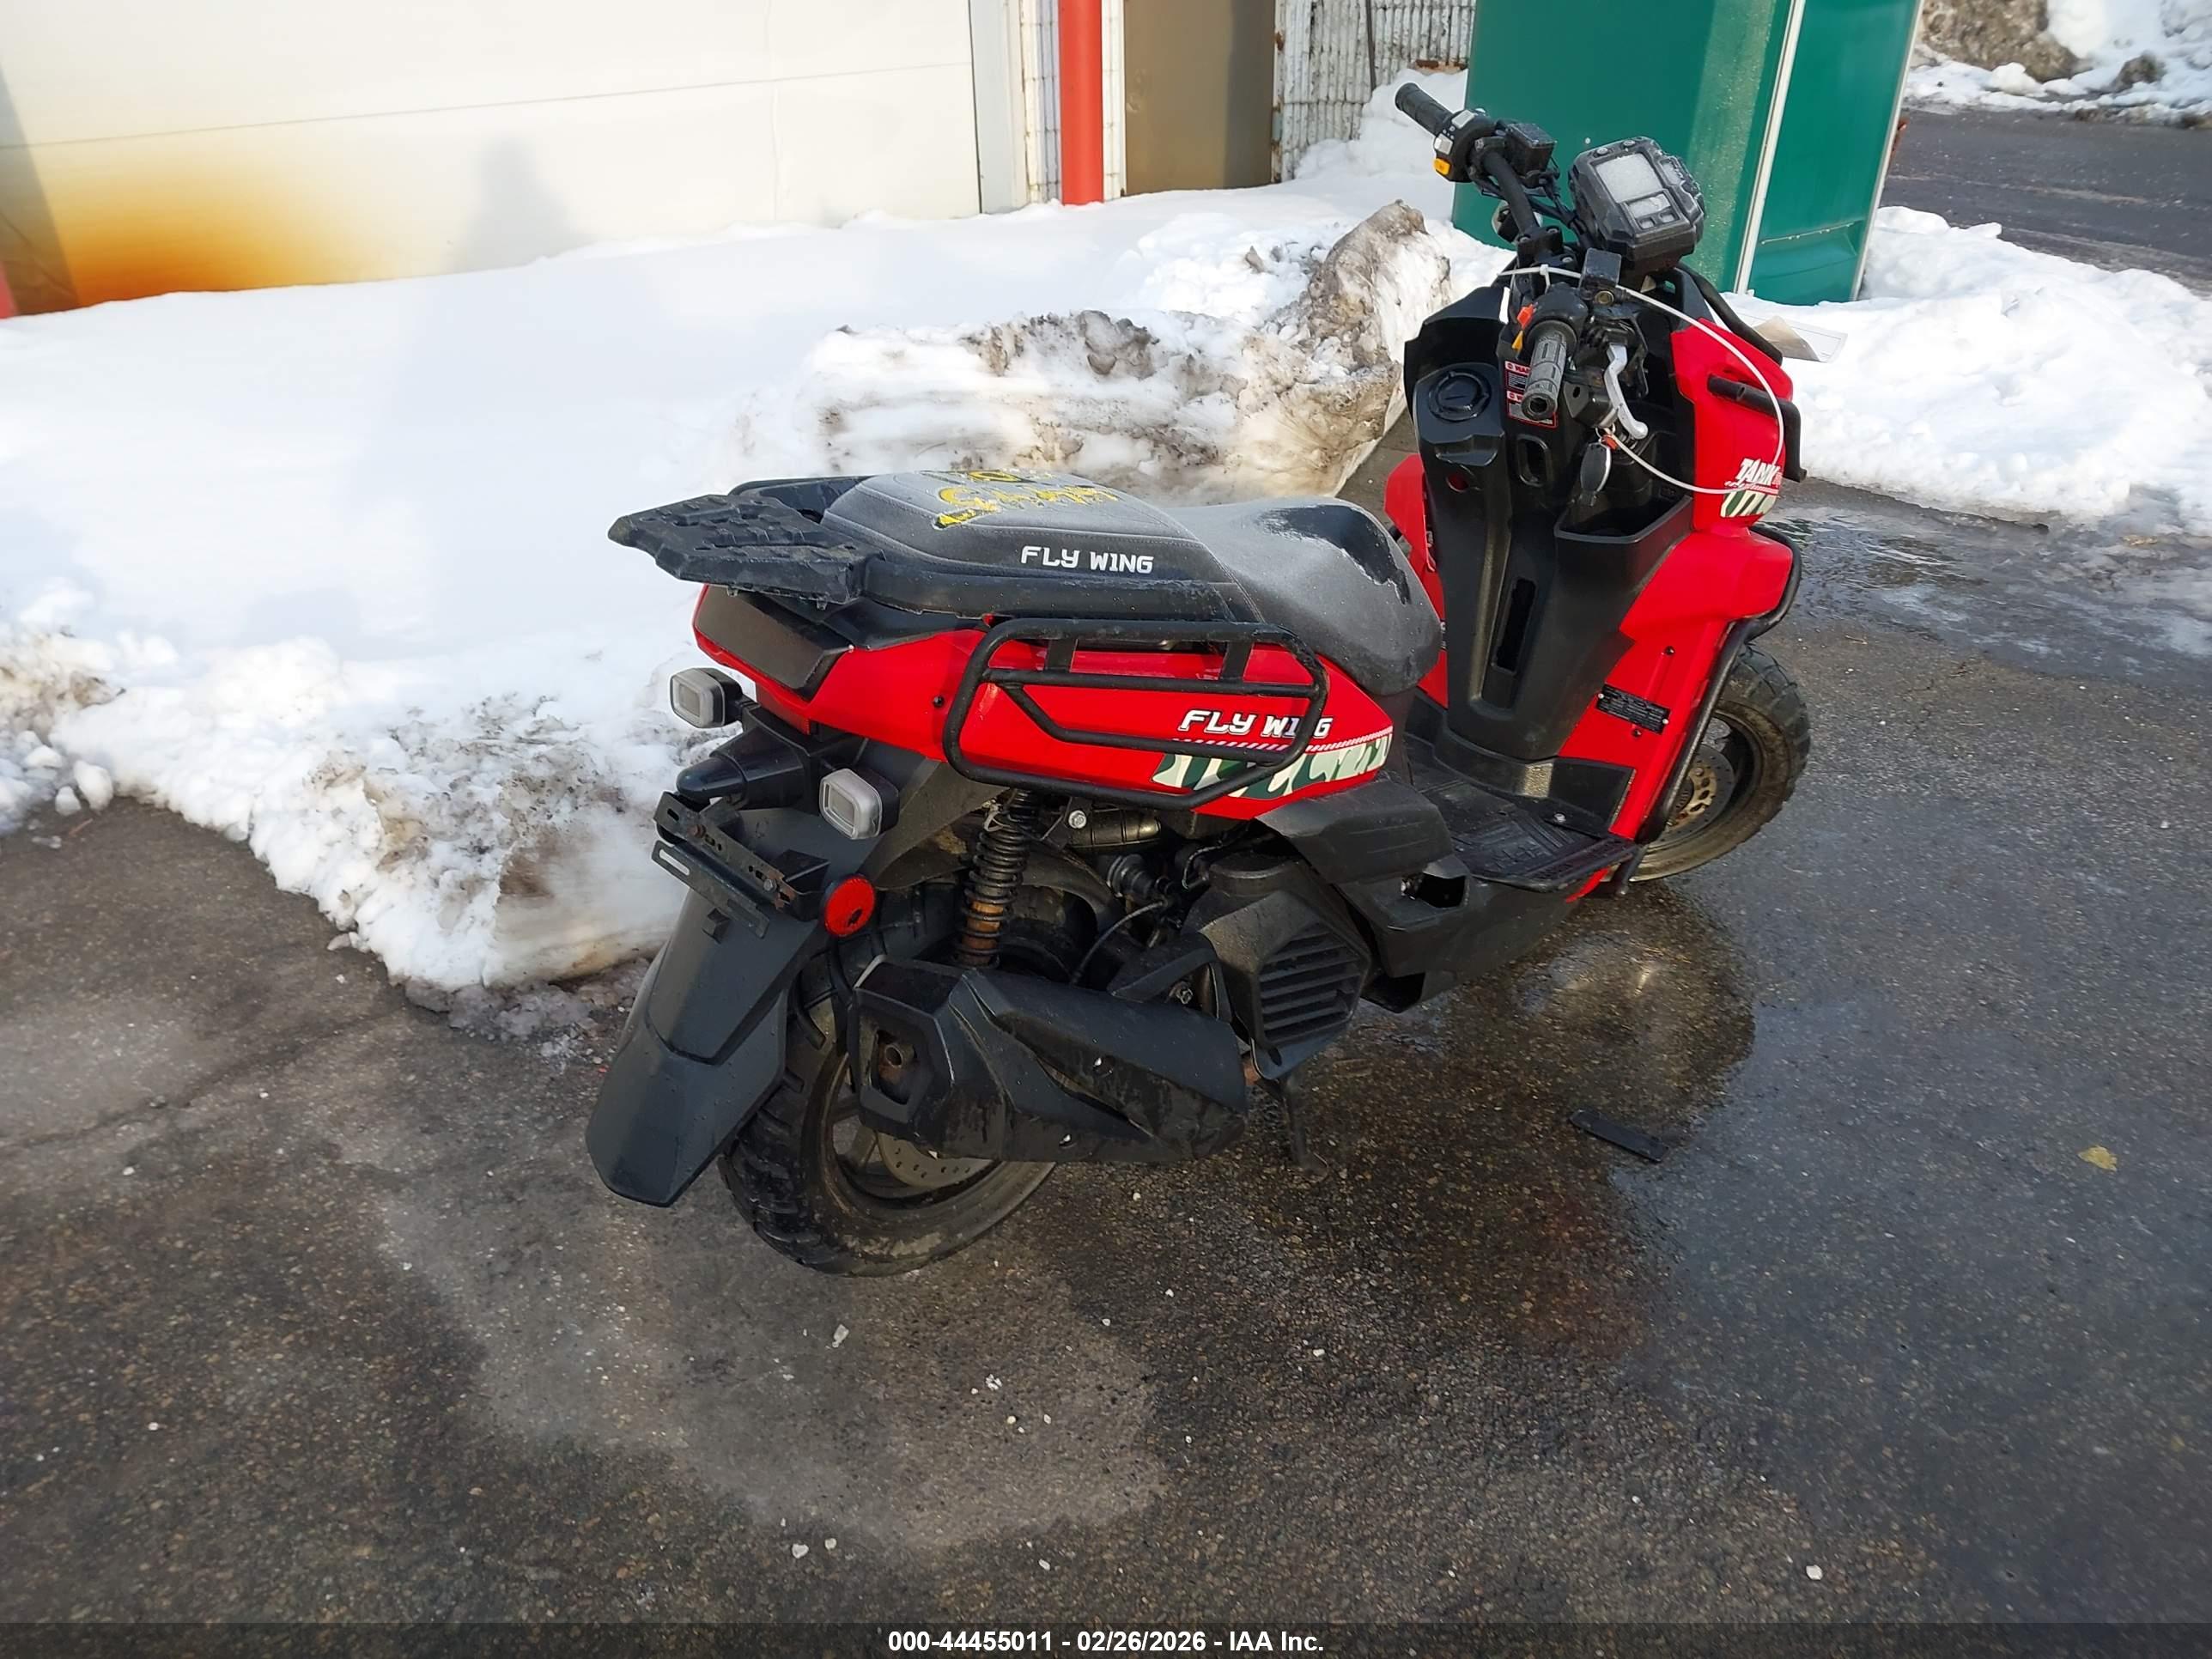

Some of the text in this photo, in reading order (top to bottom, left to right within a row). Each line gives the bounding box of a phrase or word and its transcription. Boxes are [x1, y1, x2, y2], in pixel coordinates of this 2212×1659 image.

[1735, 457, 1781, 487] TANK
[1020, 545, 1154, 574] FLY WING
[1177, 709, 1334, 739] FLY WIG
